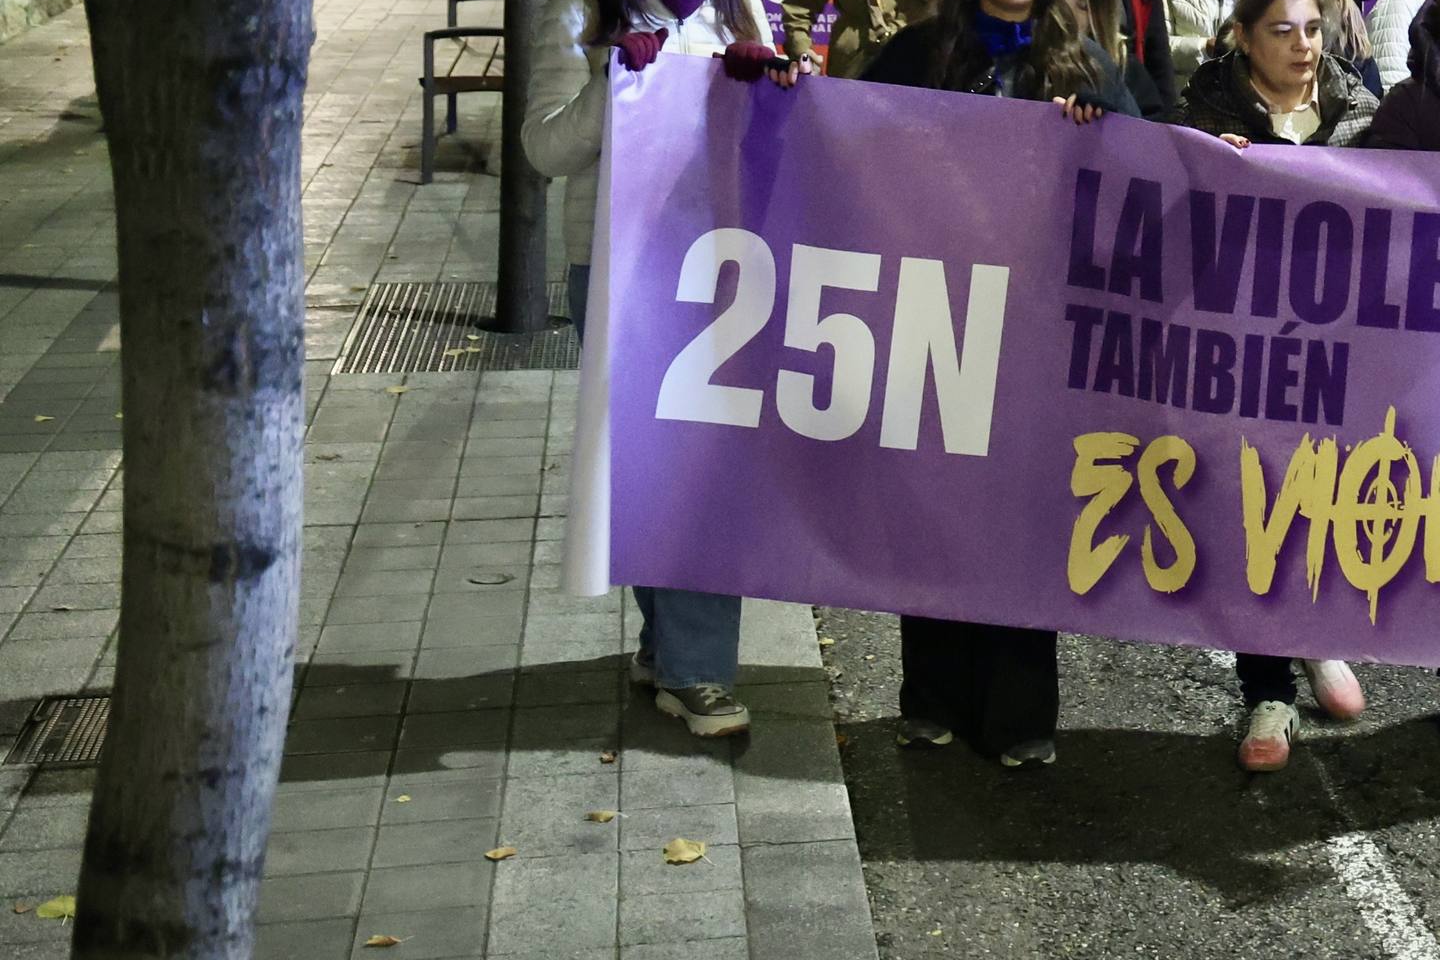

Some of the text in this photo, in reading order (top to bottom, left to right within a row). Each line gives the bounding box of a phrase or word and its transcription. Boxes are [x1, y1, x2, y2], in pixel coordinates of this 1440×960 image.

[1066, 168, 1164, 303] LA
[655, 227, 1010, 457] 25N
[1065, 303, 1349, 426] TAMBIÉN
[1067, 431, 1197, 595] ES
